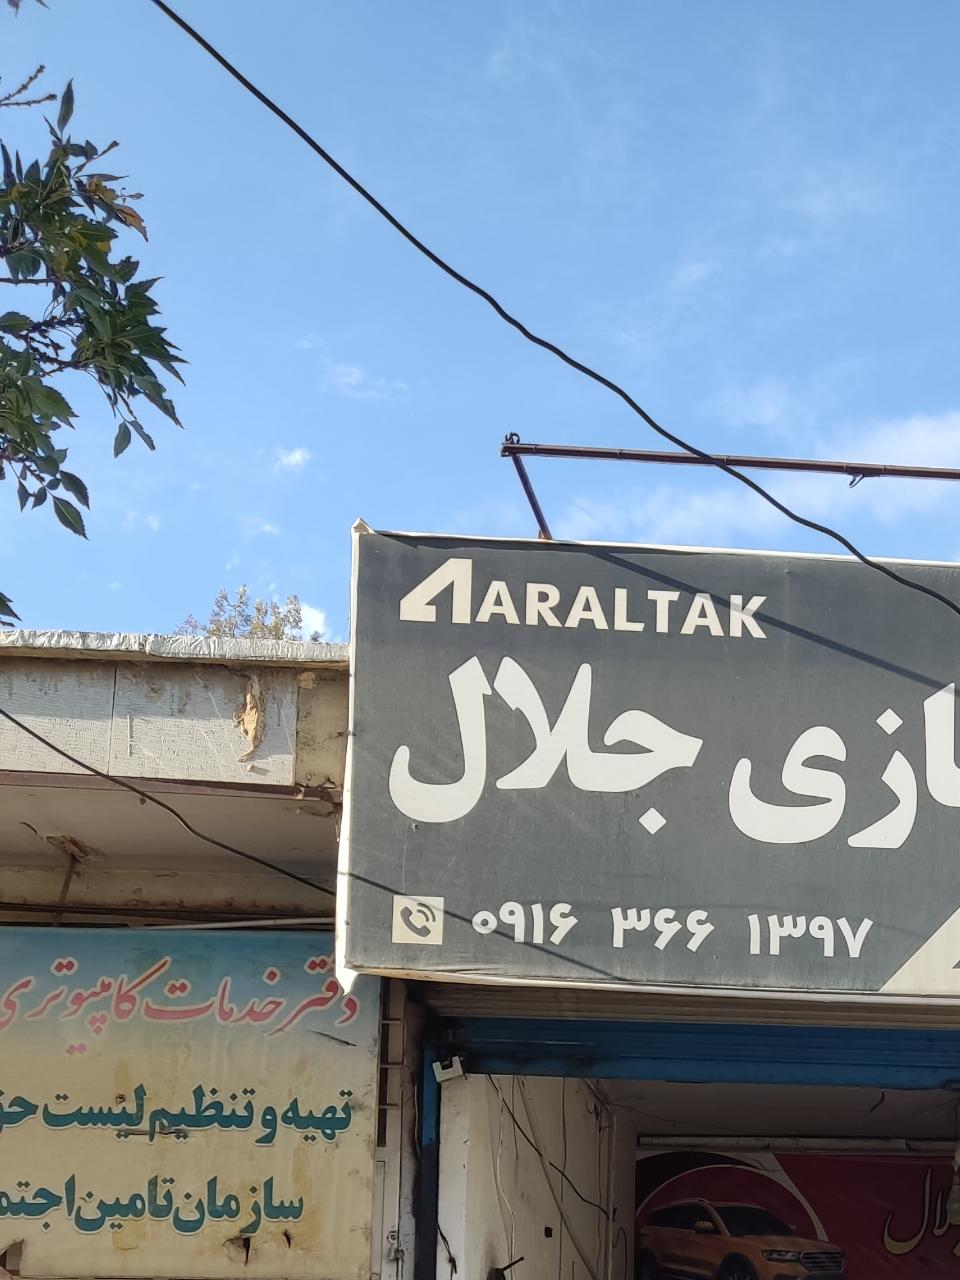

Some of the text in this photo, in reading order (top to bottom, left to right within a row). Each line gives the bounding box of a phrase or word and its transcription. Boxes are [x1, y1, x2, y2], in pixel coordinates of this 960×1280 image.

[475, 580, 768, 640] ARALTAK
[388, 655, 703, 835] جلال
[471, 901, 873, 958] ۰۹۱۶ ۳۶۶ ۱۳۹۷
[142, 967, 284, 1025] خدمات
[42, 1084, 146, 1141] لیست
[148, 1084, 256, 1143] تنظیم
[254, 1110, 279, 1145] و
[279, 1089, 354, 1143] تهیه
[0, 1174, 304, 1236] سازمان تامین اجتم
